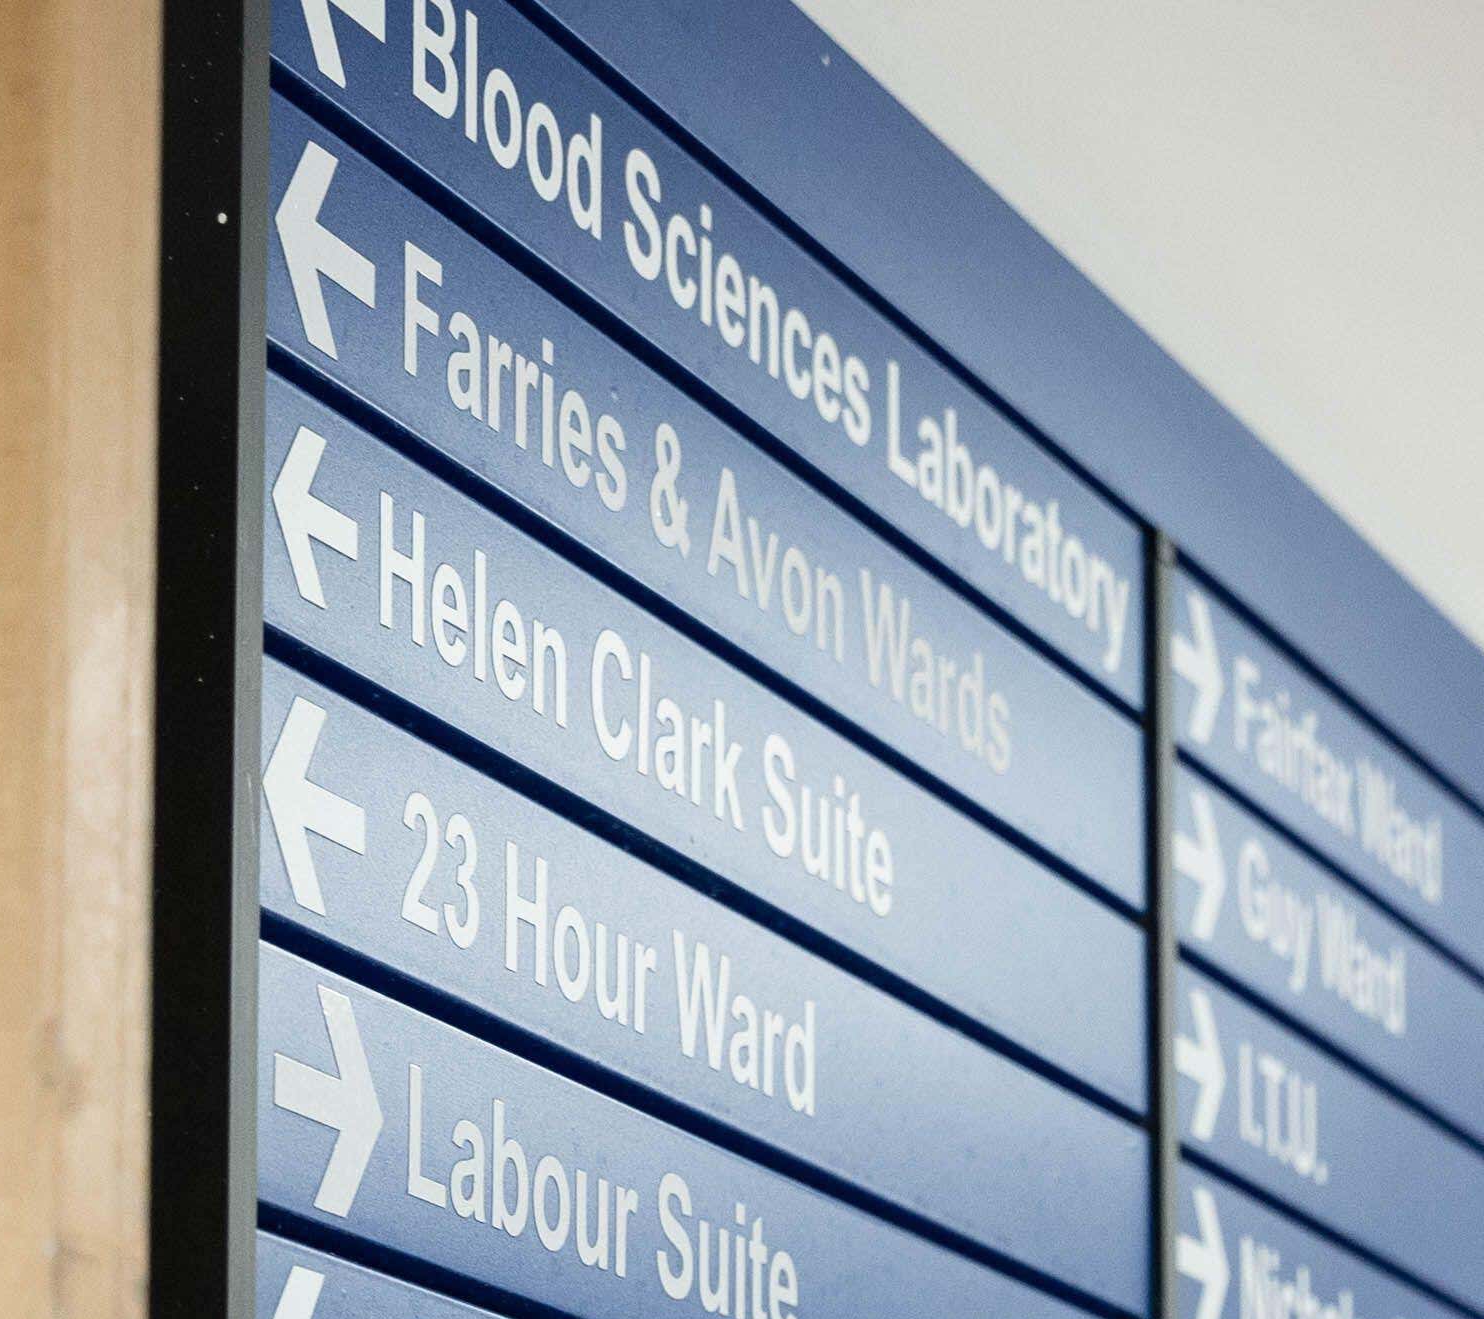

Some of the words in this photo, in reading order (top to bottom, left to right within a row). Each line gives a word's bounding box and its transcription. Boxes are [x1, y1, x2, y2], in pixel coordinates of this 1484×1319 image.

[412, 0, 603, 240] Blood
[623, 147, 871, 447] Sciences
[887, 362, 1130, 673] Laboratory
[402, 240, 627, 513] Farries
[649, 423, 691, 558] &
[707, 468, 844, 663] Avon
[859, 568, 1012, 775] Wards
[378, 490, 567, 729] Helen
[591, 629, 745, 830] Clark
[760, 734, 894, 917] Suite
[1232, 654, 1354, 840] Fairfax
[1357, 757, 1444, 904] Ward
[400, 793, 479, 949] 23
[504, 840, 658, 1036] Hour
[671, 927, 817, 1117] Ward
[1237, 838, 1309, 994] Guy
[1318, 892, 1407, 1038] Ward
[407, 1063, 639, 1279] Labour
